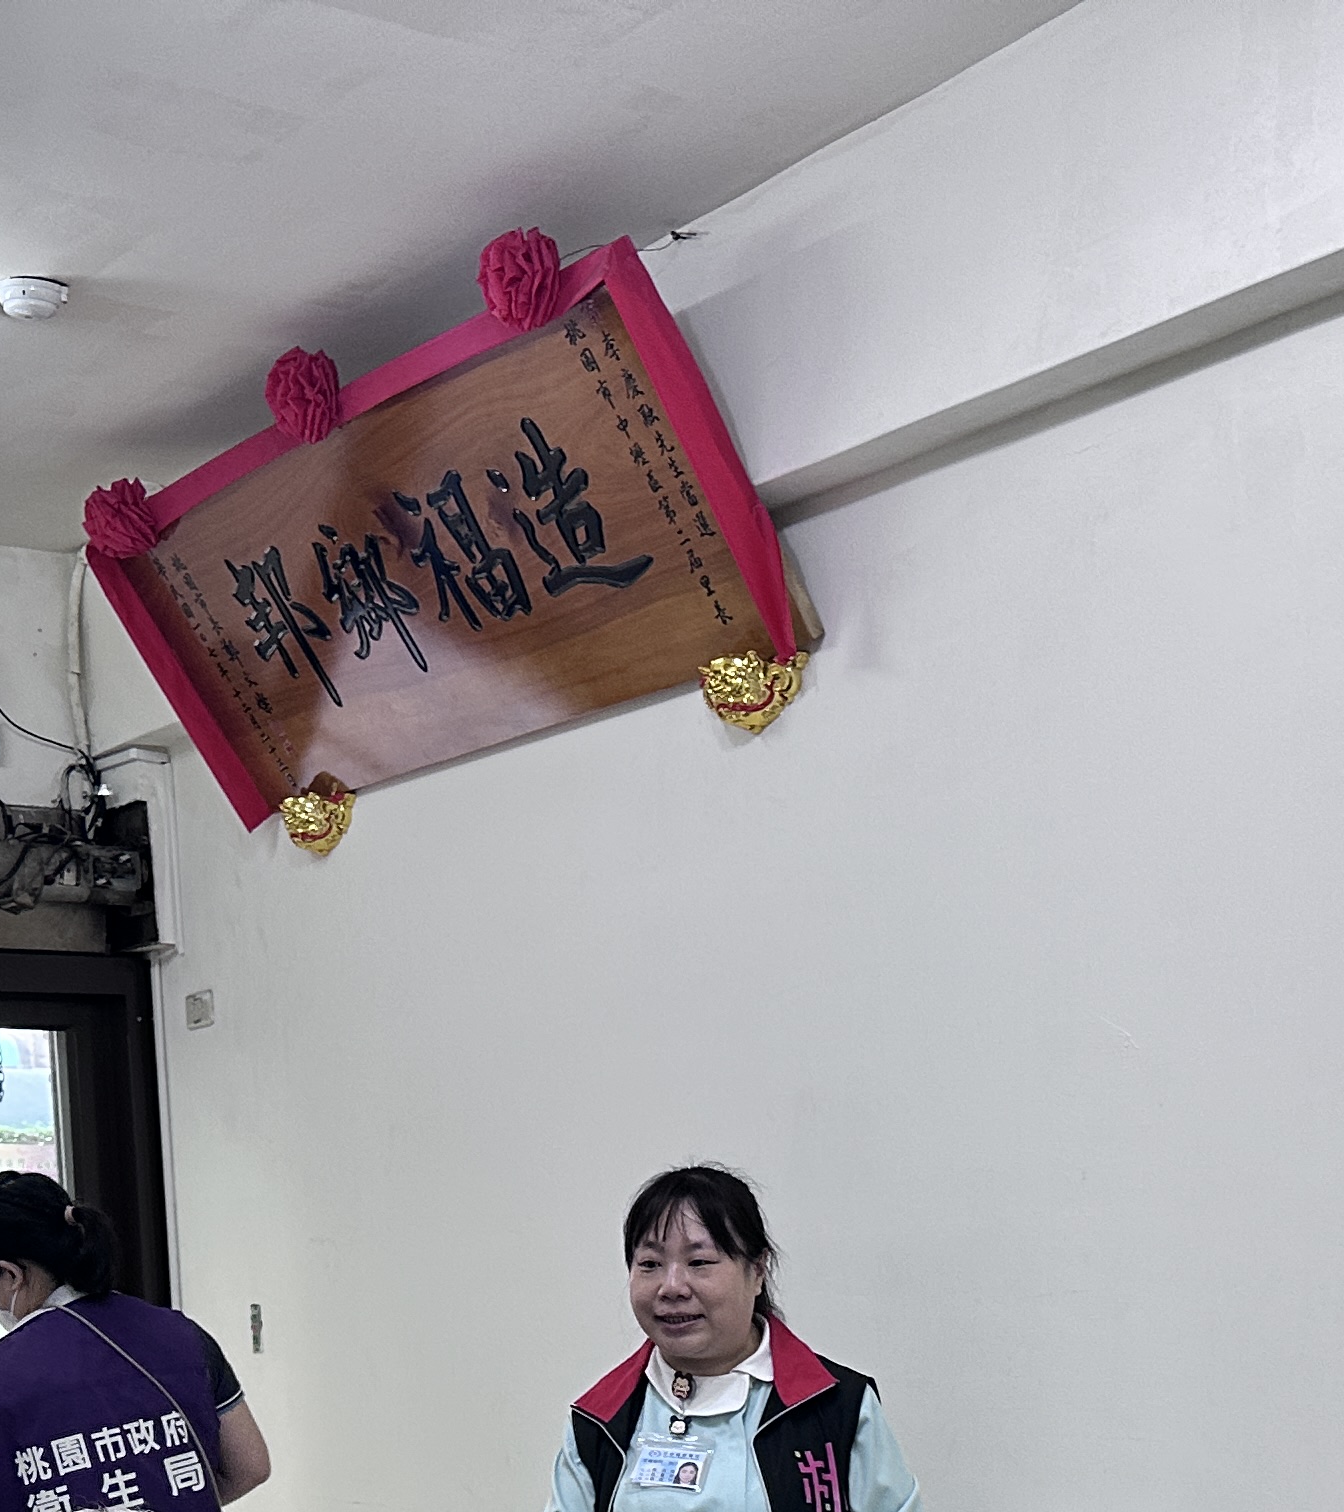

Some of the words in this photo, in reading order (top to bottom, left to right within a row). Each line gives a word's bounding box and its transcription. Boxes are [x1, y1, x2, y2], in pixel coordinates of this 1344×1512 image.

[14, 1409, 192, 1487] 桃園市政府
